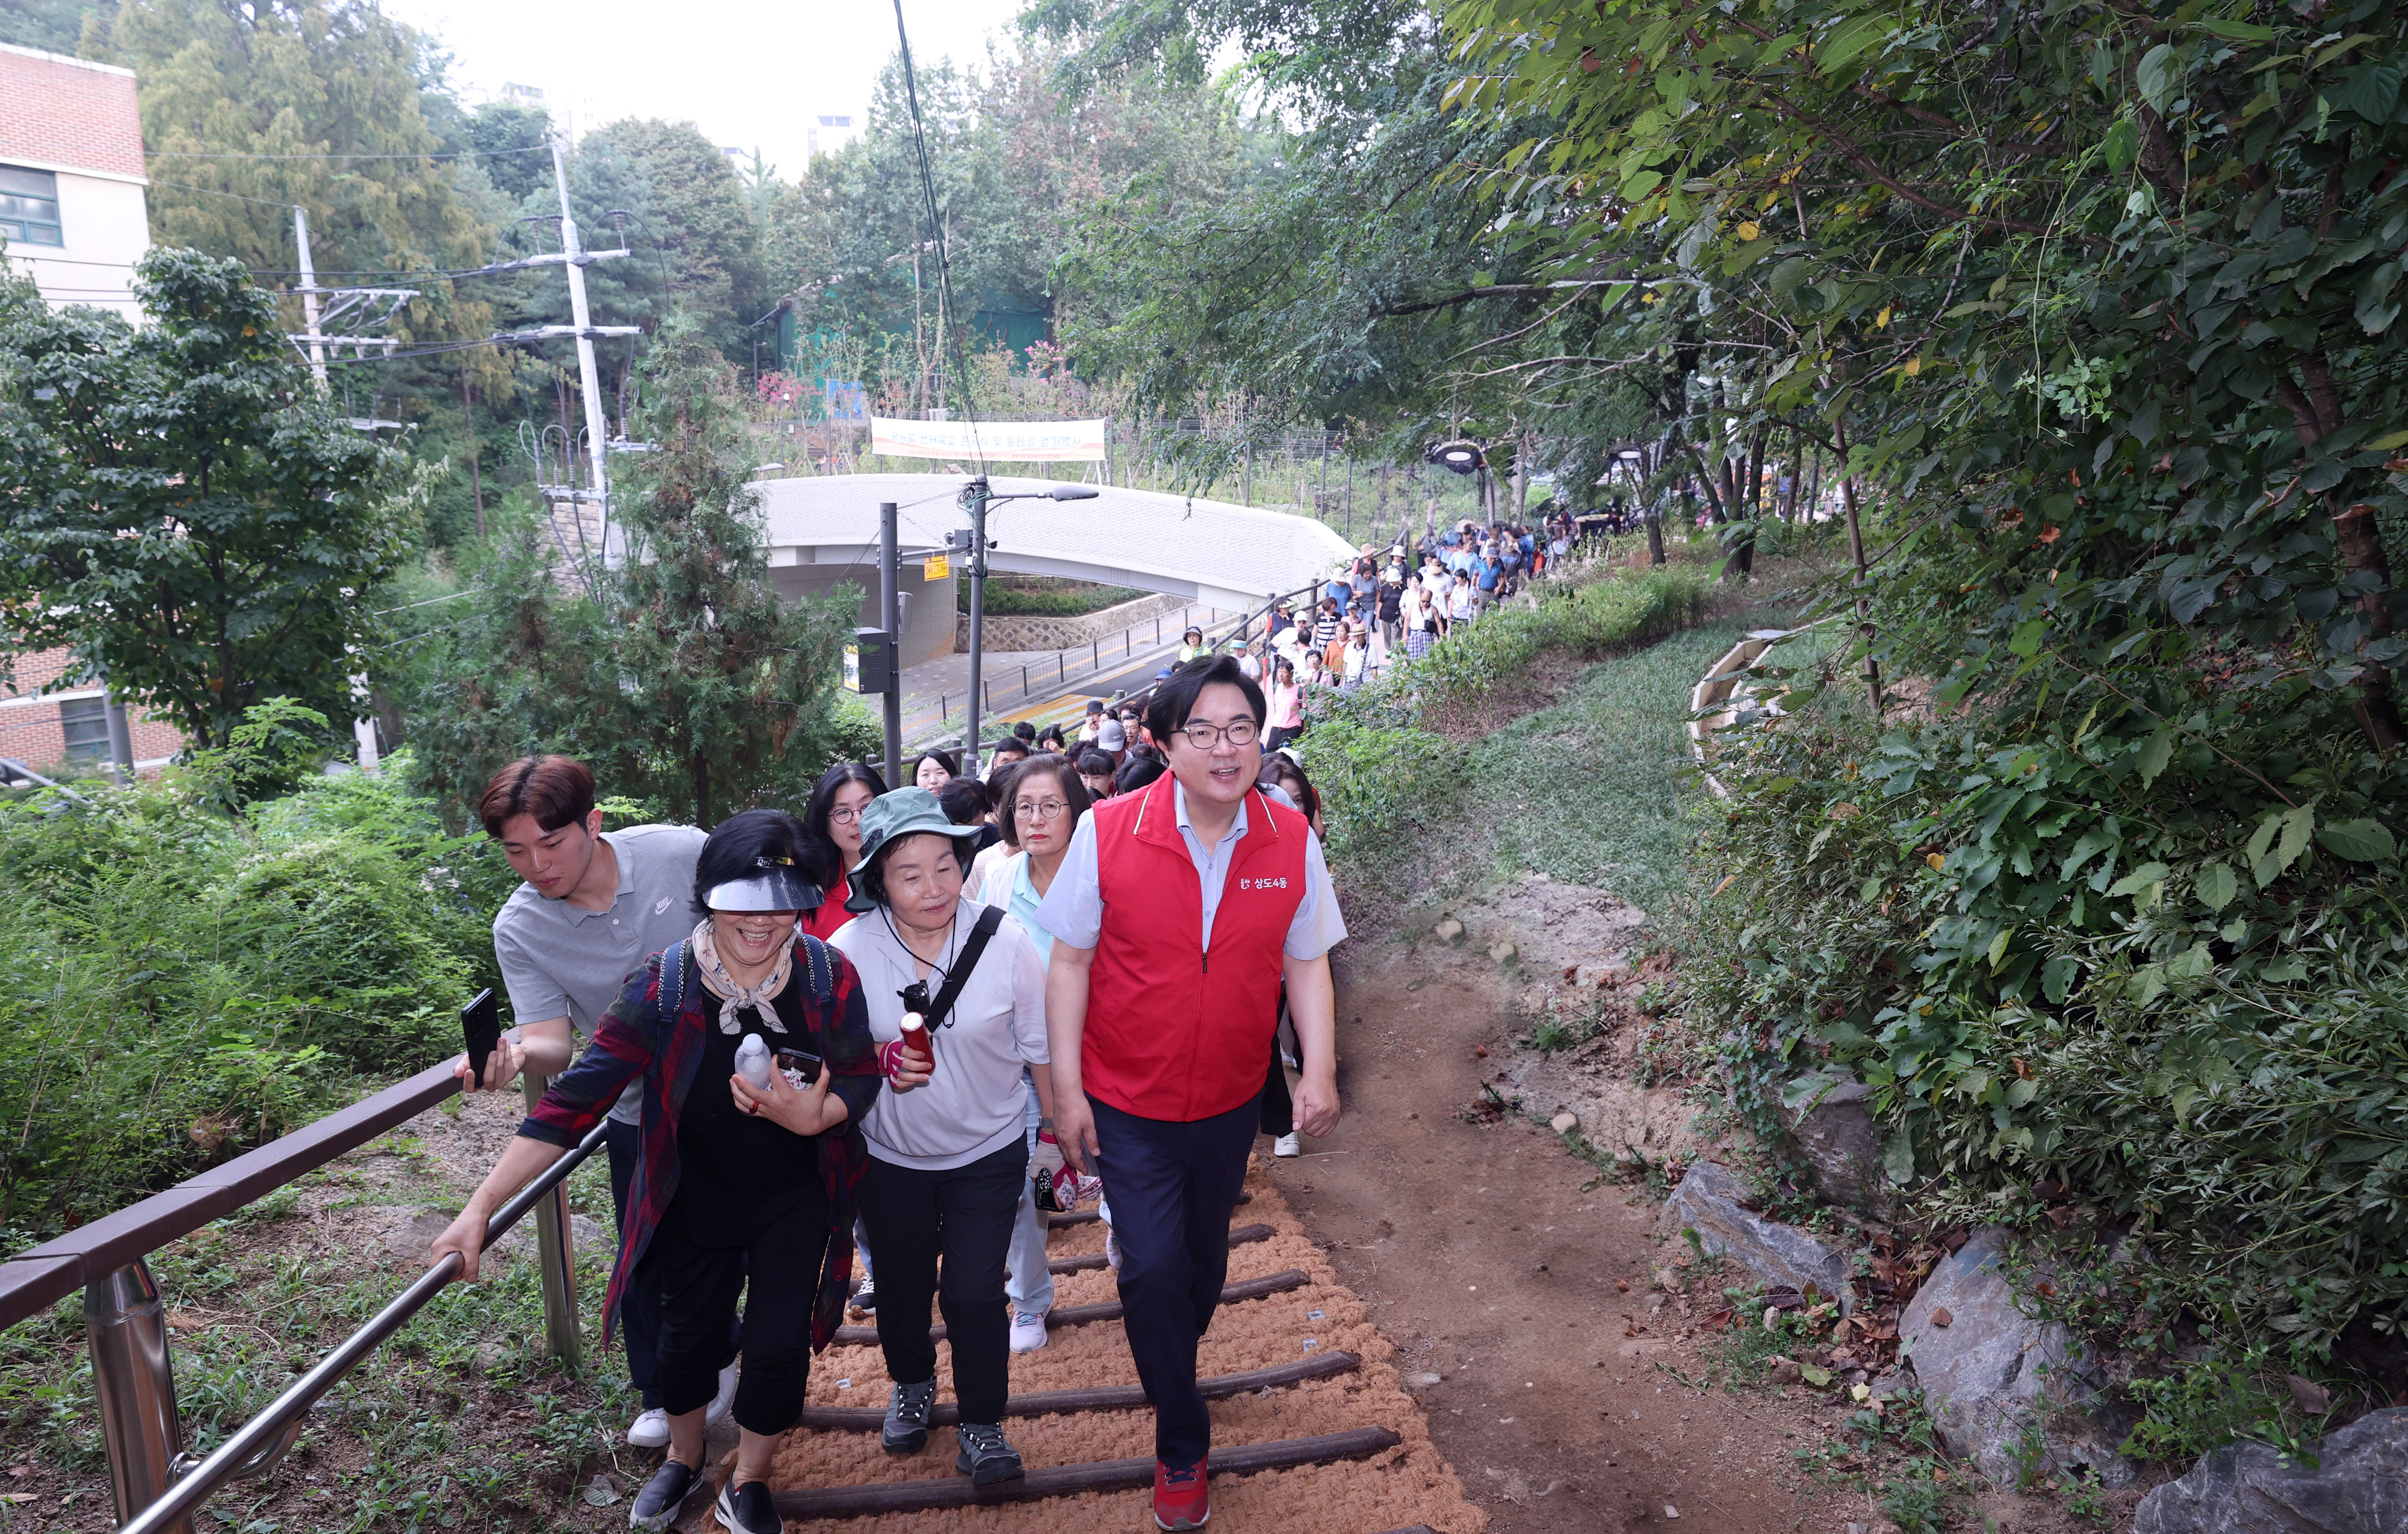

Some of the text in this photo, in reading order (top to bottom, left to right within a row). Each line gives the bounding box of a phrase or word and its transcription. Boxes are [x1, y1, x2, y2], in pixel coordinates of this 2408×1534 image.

[890, 431, 1081, 447] 국사봉 생태육교 준공식 및 둘레길 걷기행사
[1254, 877, 1288, 889] 상도4동
[656, 896, 669, 910] NIKE
